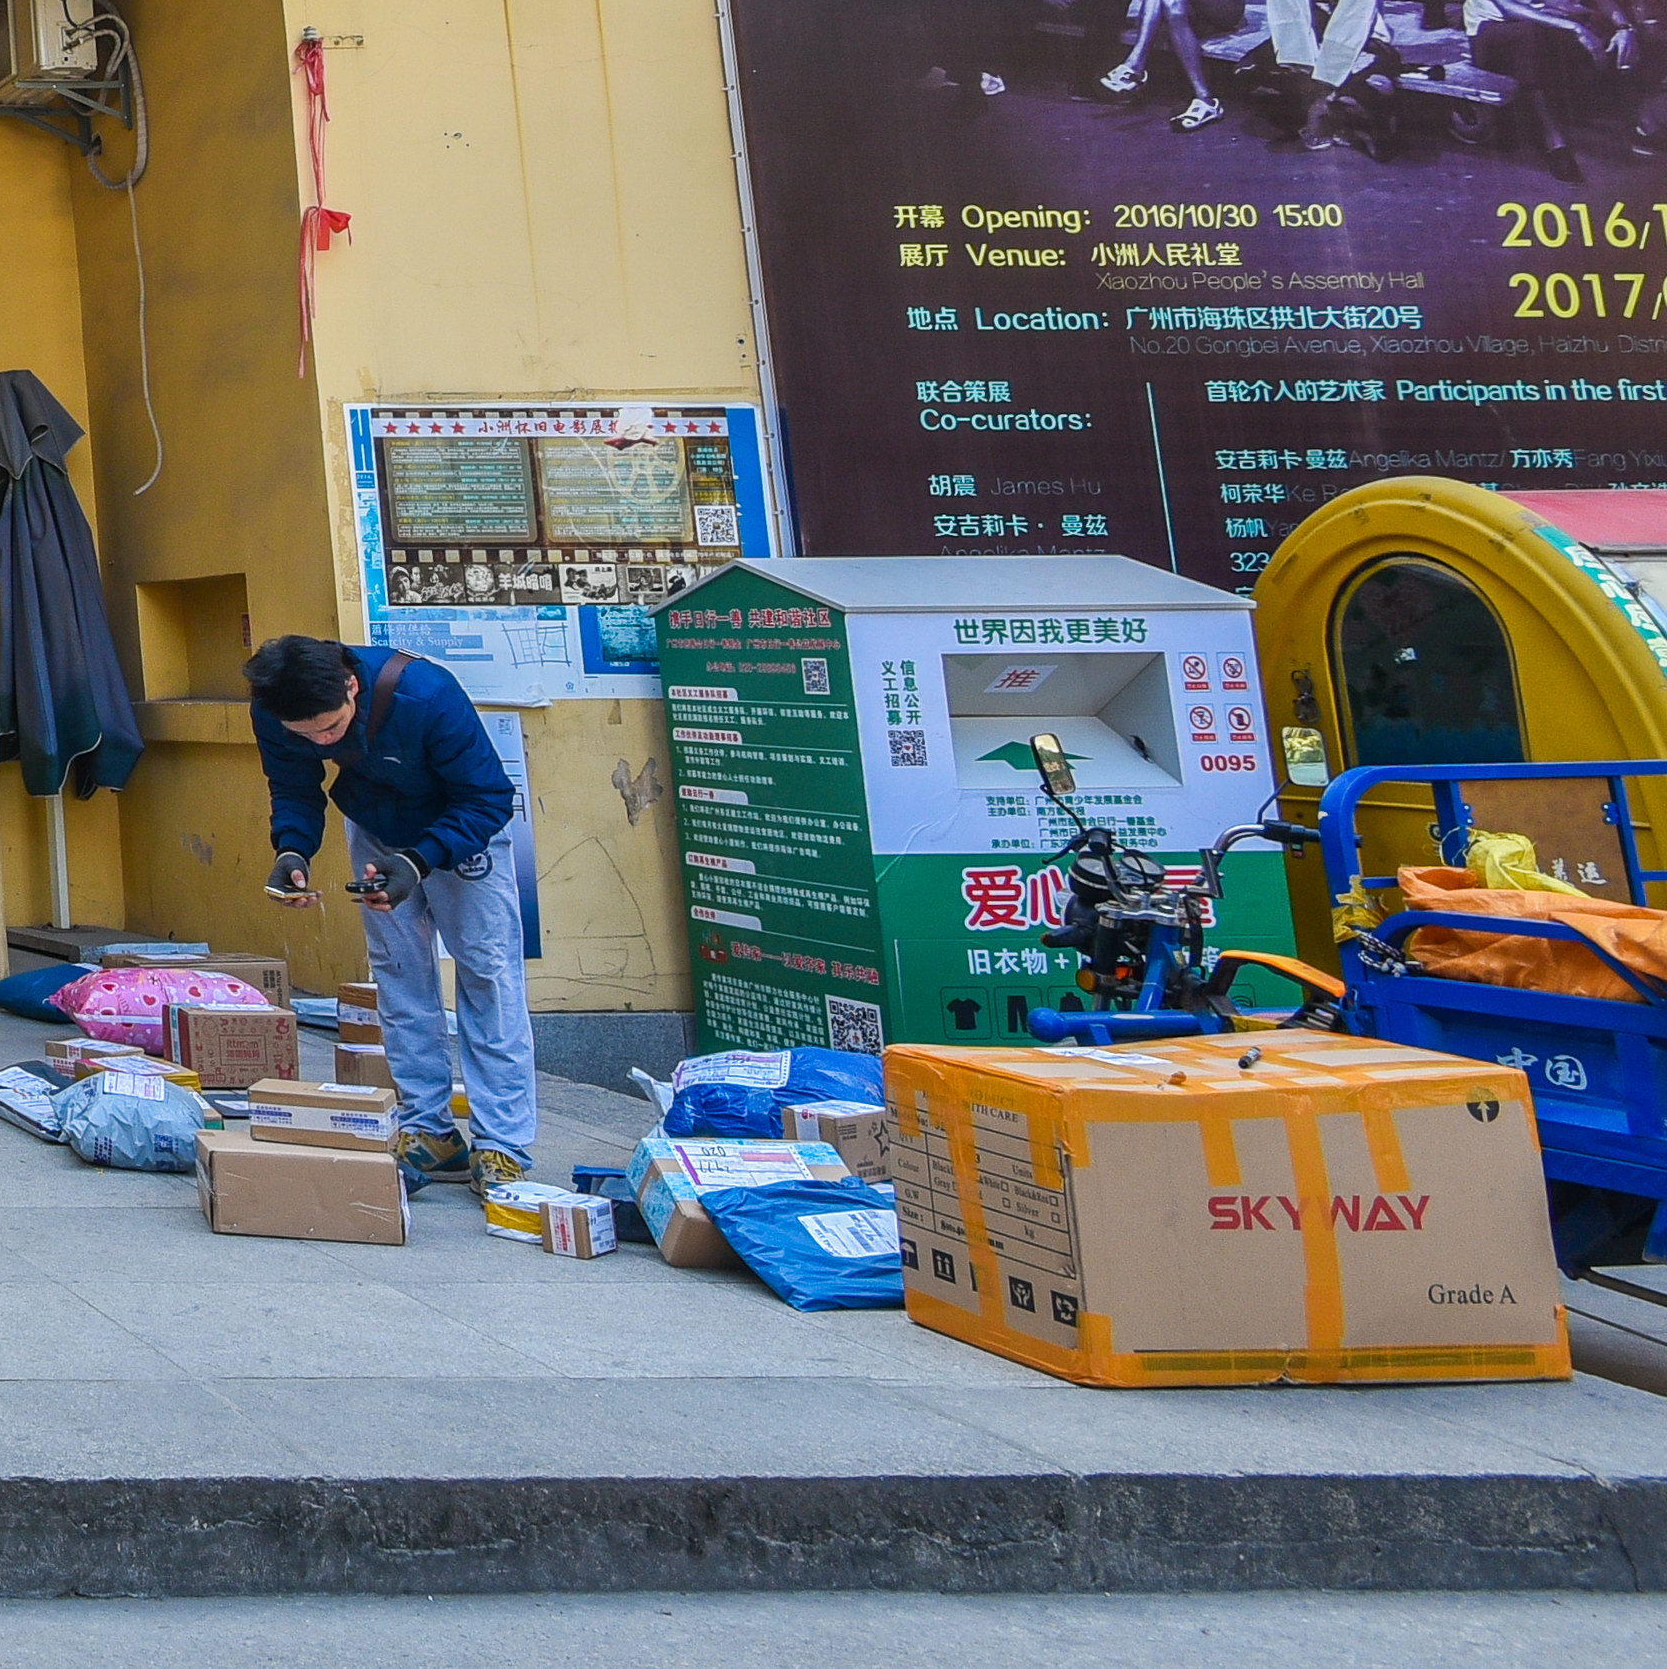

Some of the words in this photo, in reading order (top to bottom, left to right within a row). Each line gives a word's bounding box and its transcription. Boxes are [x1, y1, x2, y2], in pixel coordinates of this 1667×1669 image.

[893, 205, 945, 229] 开幕
[961, 204, 1091, 234] Opening:
[1114, 204, 1258, 230] 2016/10/30
[1273, 203, 1344, 229] 15:00
[899, 244, 949, 268] 展厅
[966, 244, 1067, 268] Venue:
[1090, 242, 1243, 268] 小洲人民礼堂
[1096, 271, 1188, 292] Xiaozhou
[1289, 270, 1385, 293] Assembly
[1389, 271, 1425, 291] Hall
[906, 306, 958, 331] 地点
[975, 307, 1110, 331] Location:
[1125, 305, 1423, 332] 广州市海珠区拱北大街20号
[1130, 336, 1191, 355] No.20
[1196, 336, 1280, 359] Gongbei
[1285, 335, 1367, 356] Avenue,
[1371, 335, 1463, 354] Xiaozhou
[1467, 335, 1535, 357] Village,
[1540, 335, 1608, 354] Haizhu
[916, 381, 1012, 404] 联合策展
[1396, 379, 1541, 407] Participants
[1544, 379, 1567, 401] in
[1571, 379, 1613, 401] the
[1618, 379, 1667, 402] first
[920, 408, 1093, 432] Co-curators:
[1510, 448, 1574, 470] 方亦秀
[928, 474, 978, 497] 胡震
[990, 477, 1065, 497] James
[1069, 477, 1102, 497] Hu
[1219, 483, 1286, 504] 柯荣华
[1225, 517, 1268, 539] 杨帆
[669, 609, 743, 629] 携手日行一善
[748, 608, 831, 628] 共建和谐社区
[371, 636, 416, 648] Scarcity
[418, 637, 426, 647] &
[428, 636, 465, 650] Supply
[953, 617, 1149, 646] 世界因我更美好
[994, 668, 1041, 689] 推
[1200, 754, 1256, 772] 0095
[989, 1107, 1019, 1123] CARE
[1012, 1164, 1034, 1180] Units
[1016, 1201, 1040, 1219] Silver
[1208, 1195, 1432, 1231] SKYWAY
[1427, 1282, 1494, 1307] Grade
[1498, 1283, 1518, 1305] A
